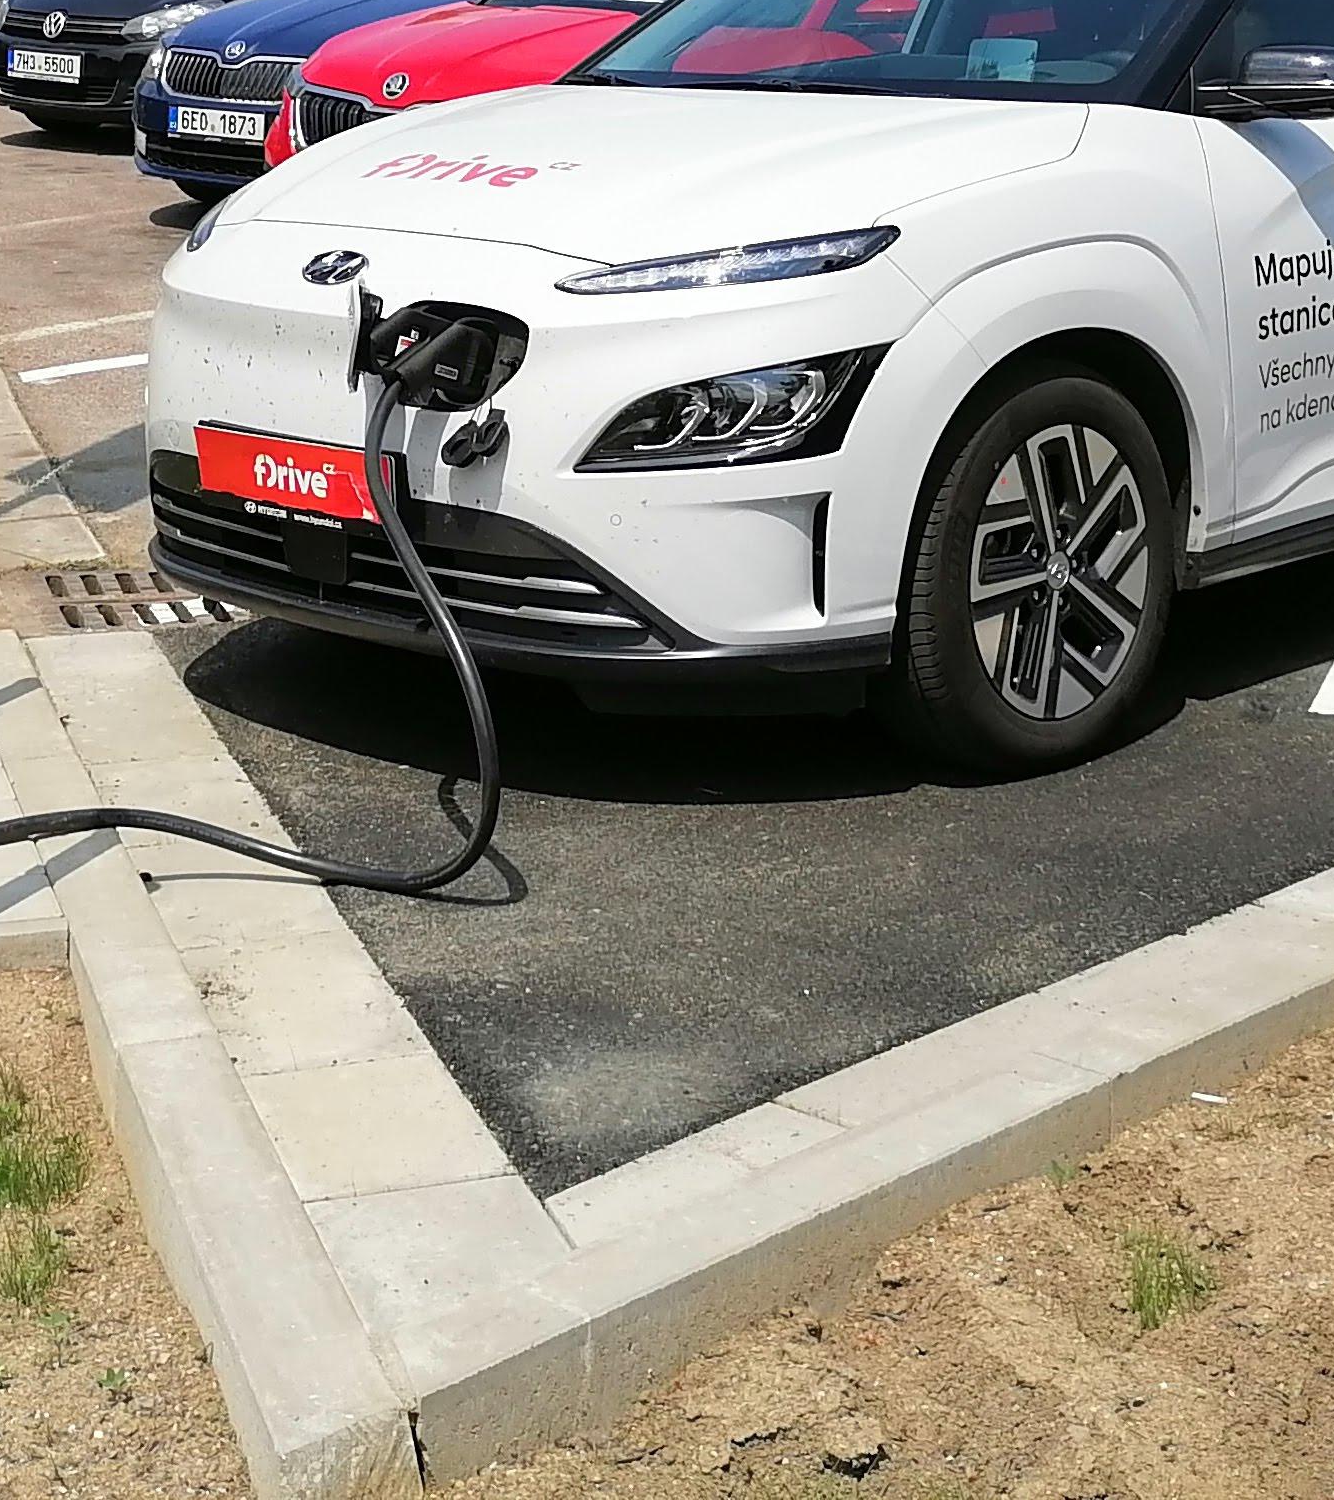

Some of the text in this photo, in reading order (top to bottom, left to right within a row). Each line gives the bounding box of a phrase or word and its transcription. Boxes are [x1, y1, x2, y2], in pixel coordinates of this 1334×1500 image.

[16, 53, 74, 74] 7H3 5500
[219, 114, 256, 136] 1873
[1260, 408, 1281, 433] na
